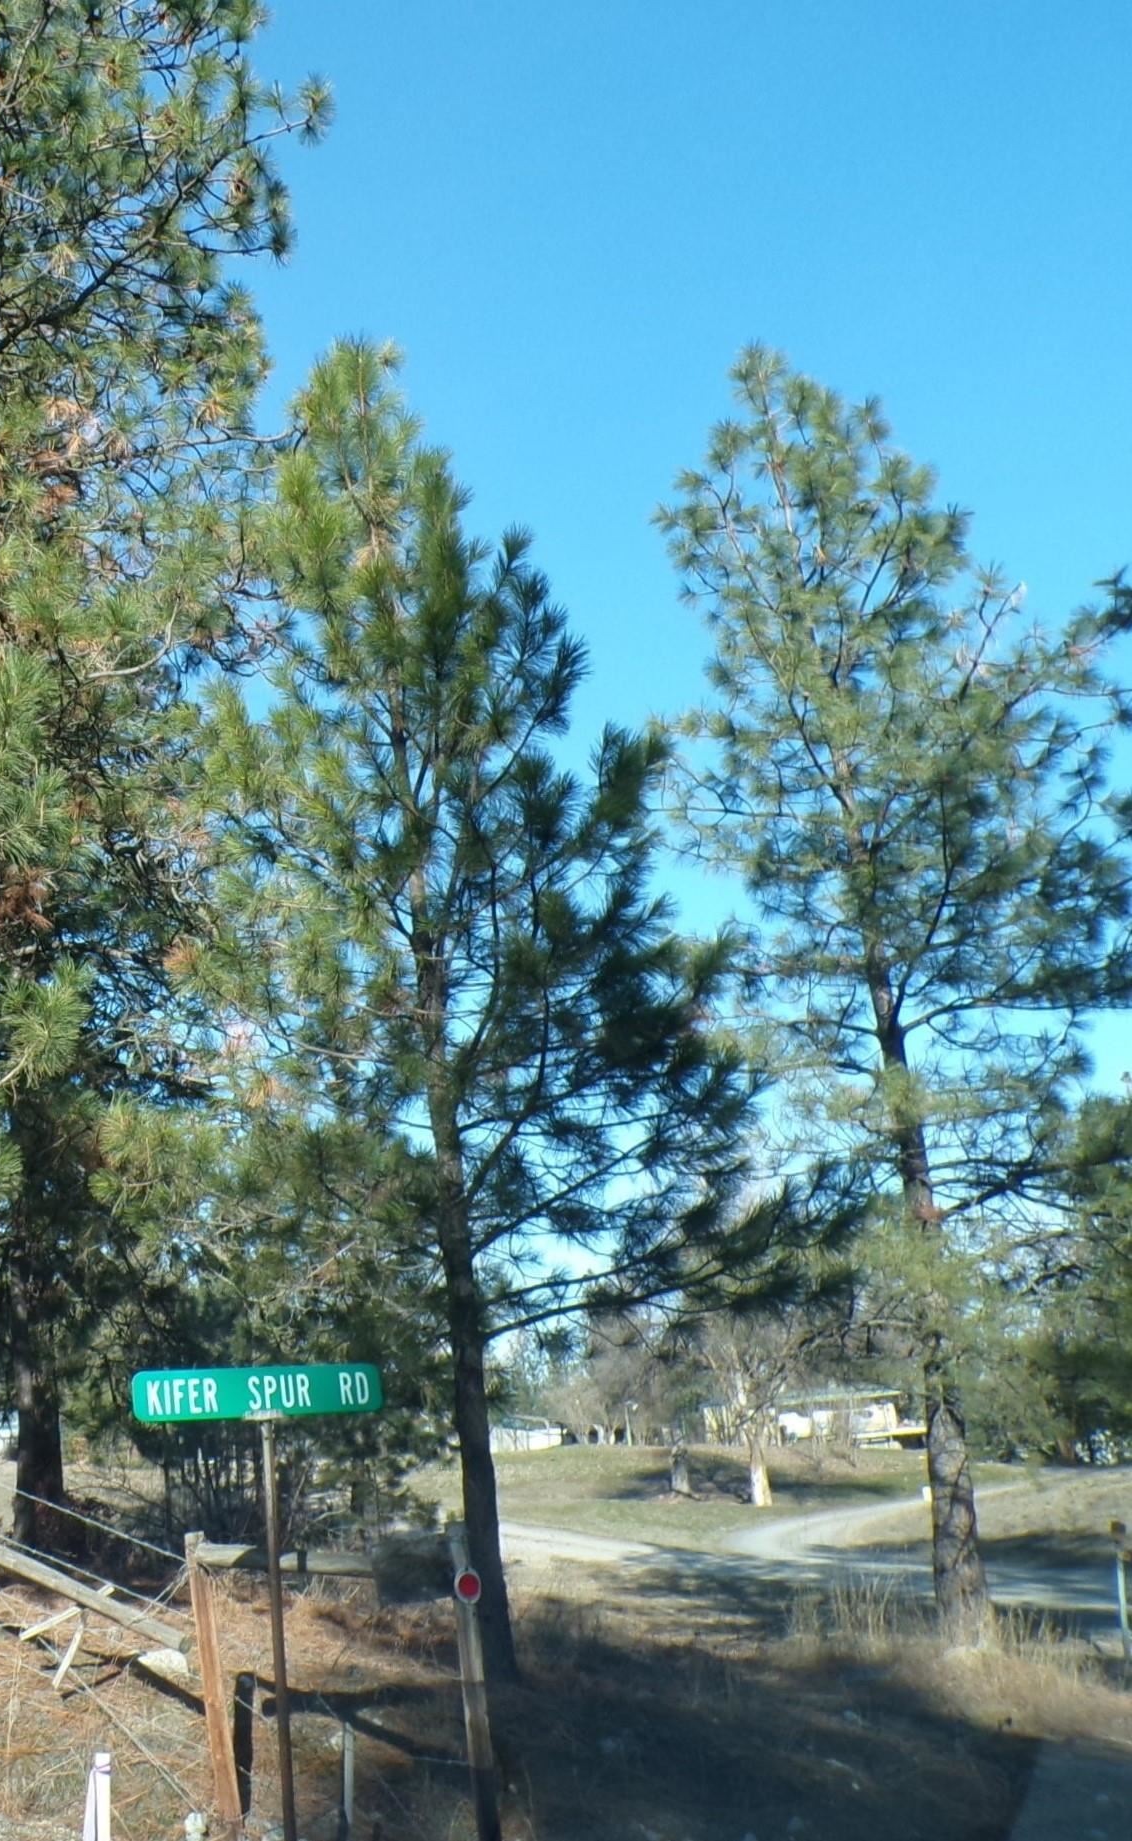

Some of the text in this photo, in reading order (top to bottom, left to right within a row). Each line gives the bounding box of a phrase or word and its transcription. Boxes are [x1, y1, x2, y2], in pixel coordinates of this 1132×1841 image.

[146, 1371, 369, 1416] KIFER SPUR RD
